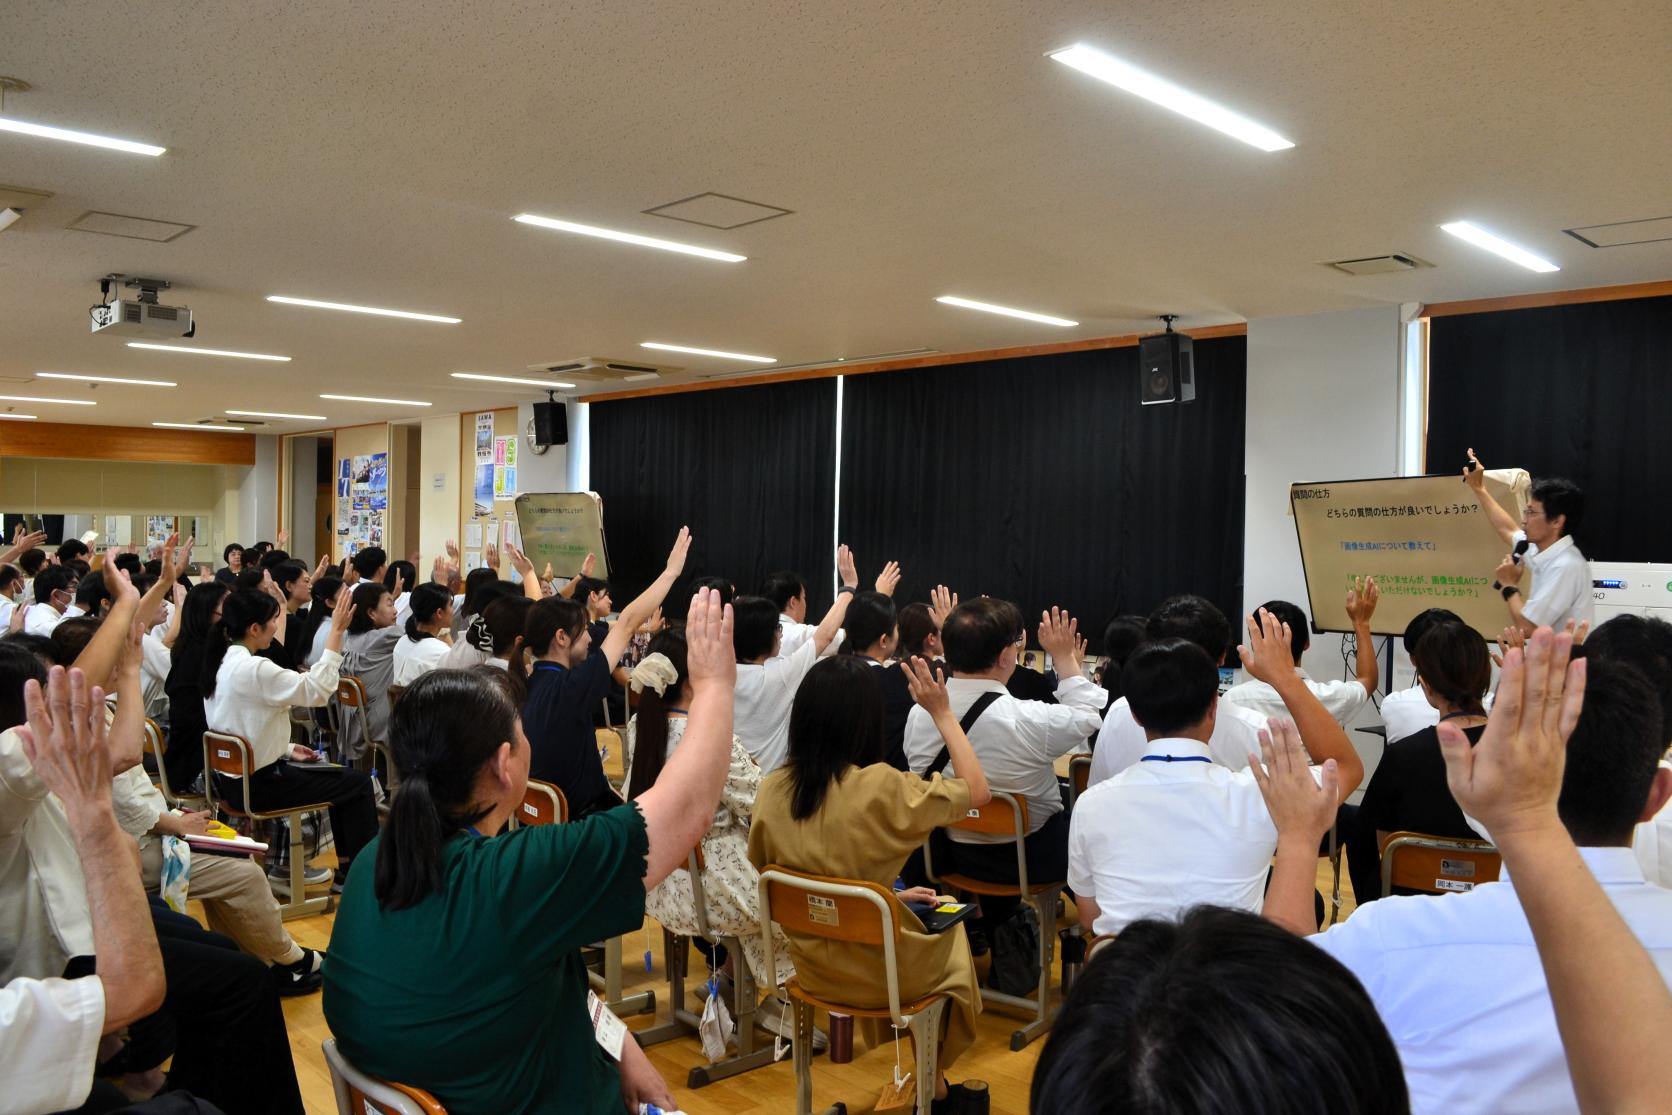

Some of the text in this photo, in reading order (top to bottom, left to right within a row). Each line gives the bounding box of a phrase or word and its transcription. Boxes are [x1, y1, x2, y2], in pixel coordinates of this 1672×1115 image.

[1293, 488, 1330, 499] 質問の仕方
